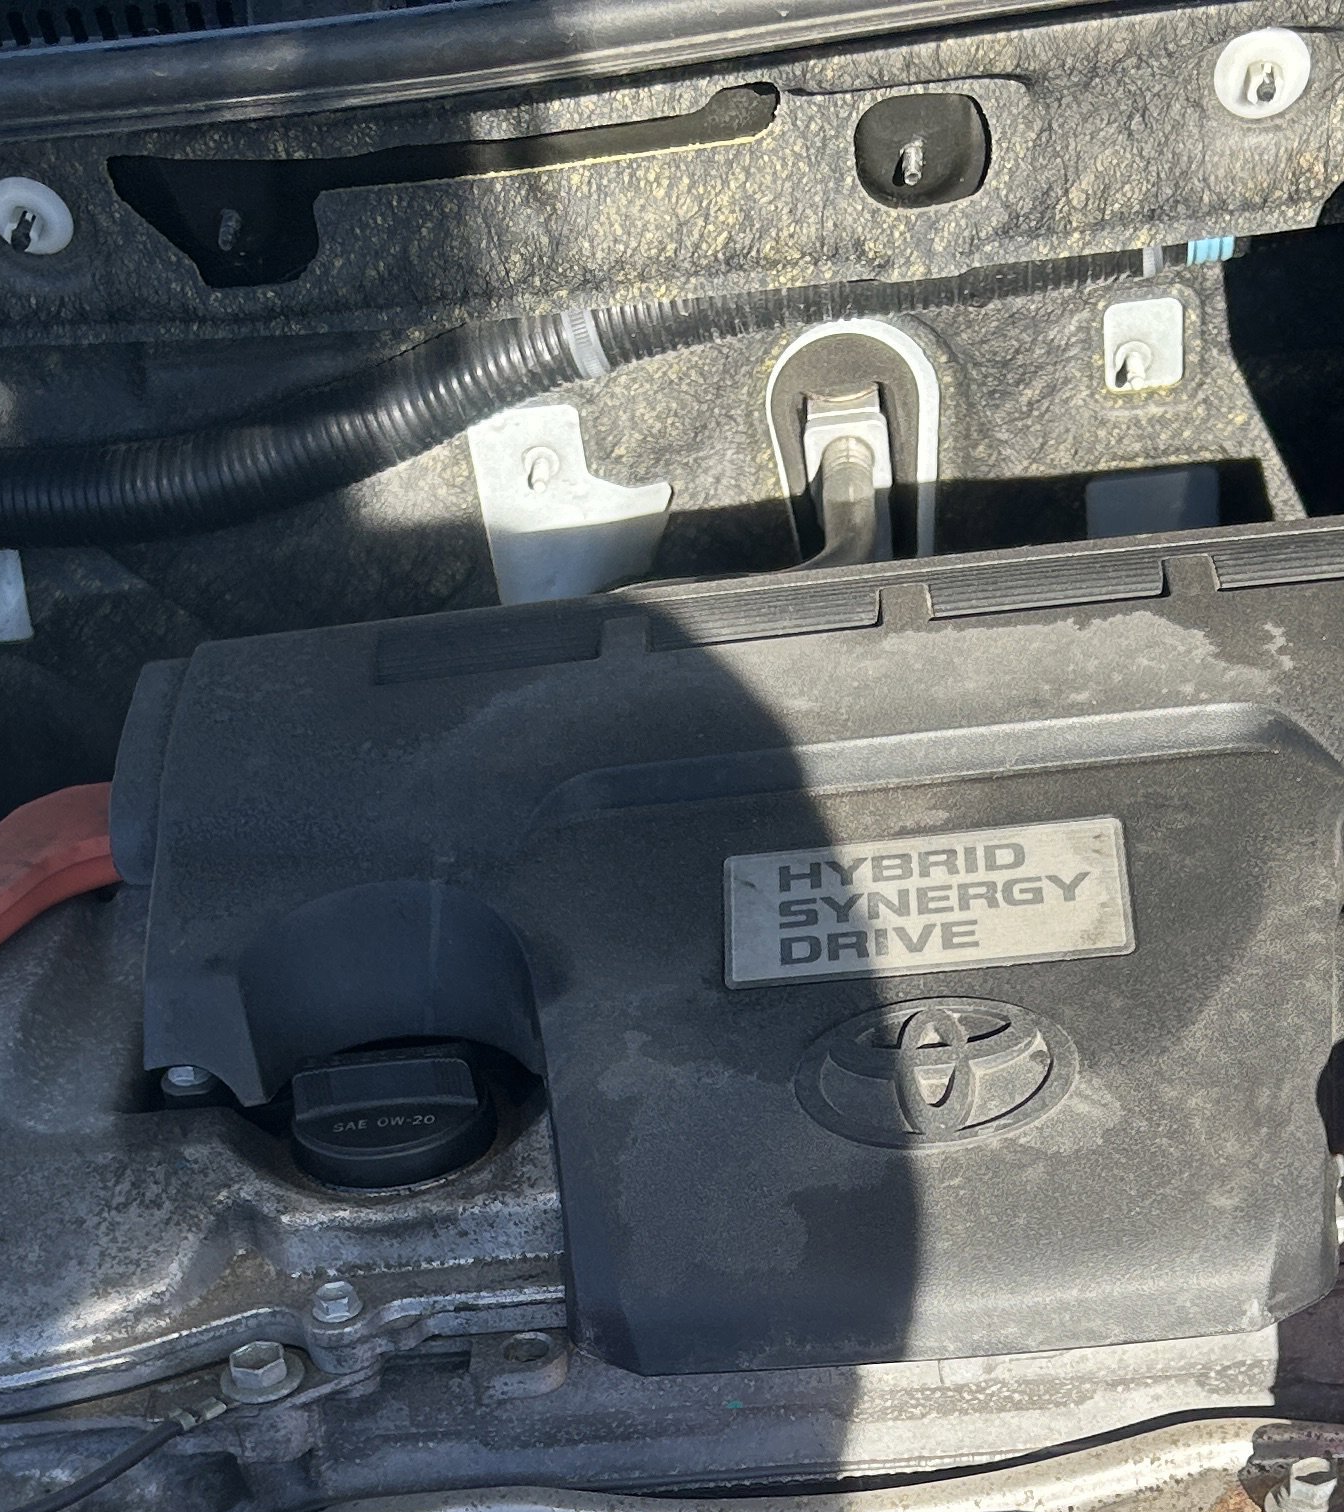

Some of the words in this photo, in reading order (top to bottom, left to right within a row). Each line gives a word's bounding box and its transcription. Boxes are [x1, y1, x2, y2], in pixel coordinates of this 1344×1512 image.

[778, 842, 1026, 892] HYBRID
[778, 871, 1091, 930] SYNERGY
[778, 918, 981, 966] DRIVE
[332, 1118, 368, 1133] SAE
